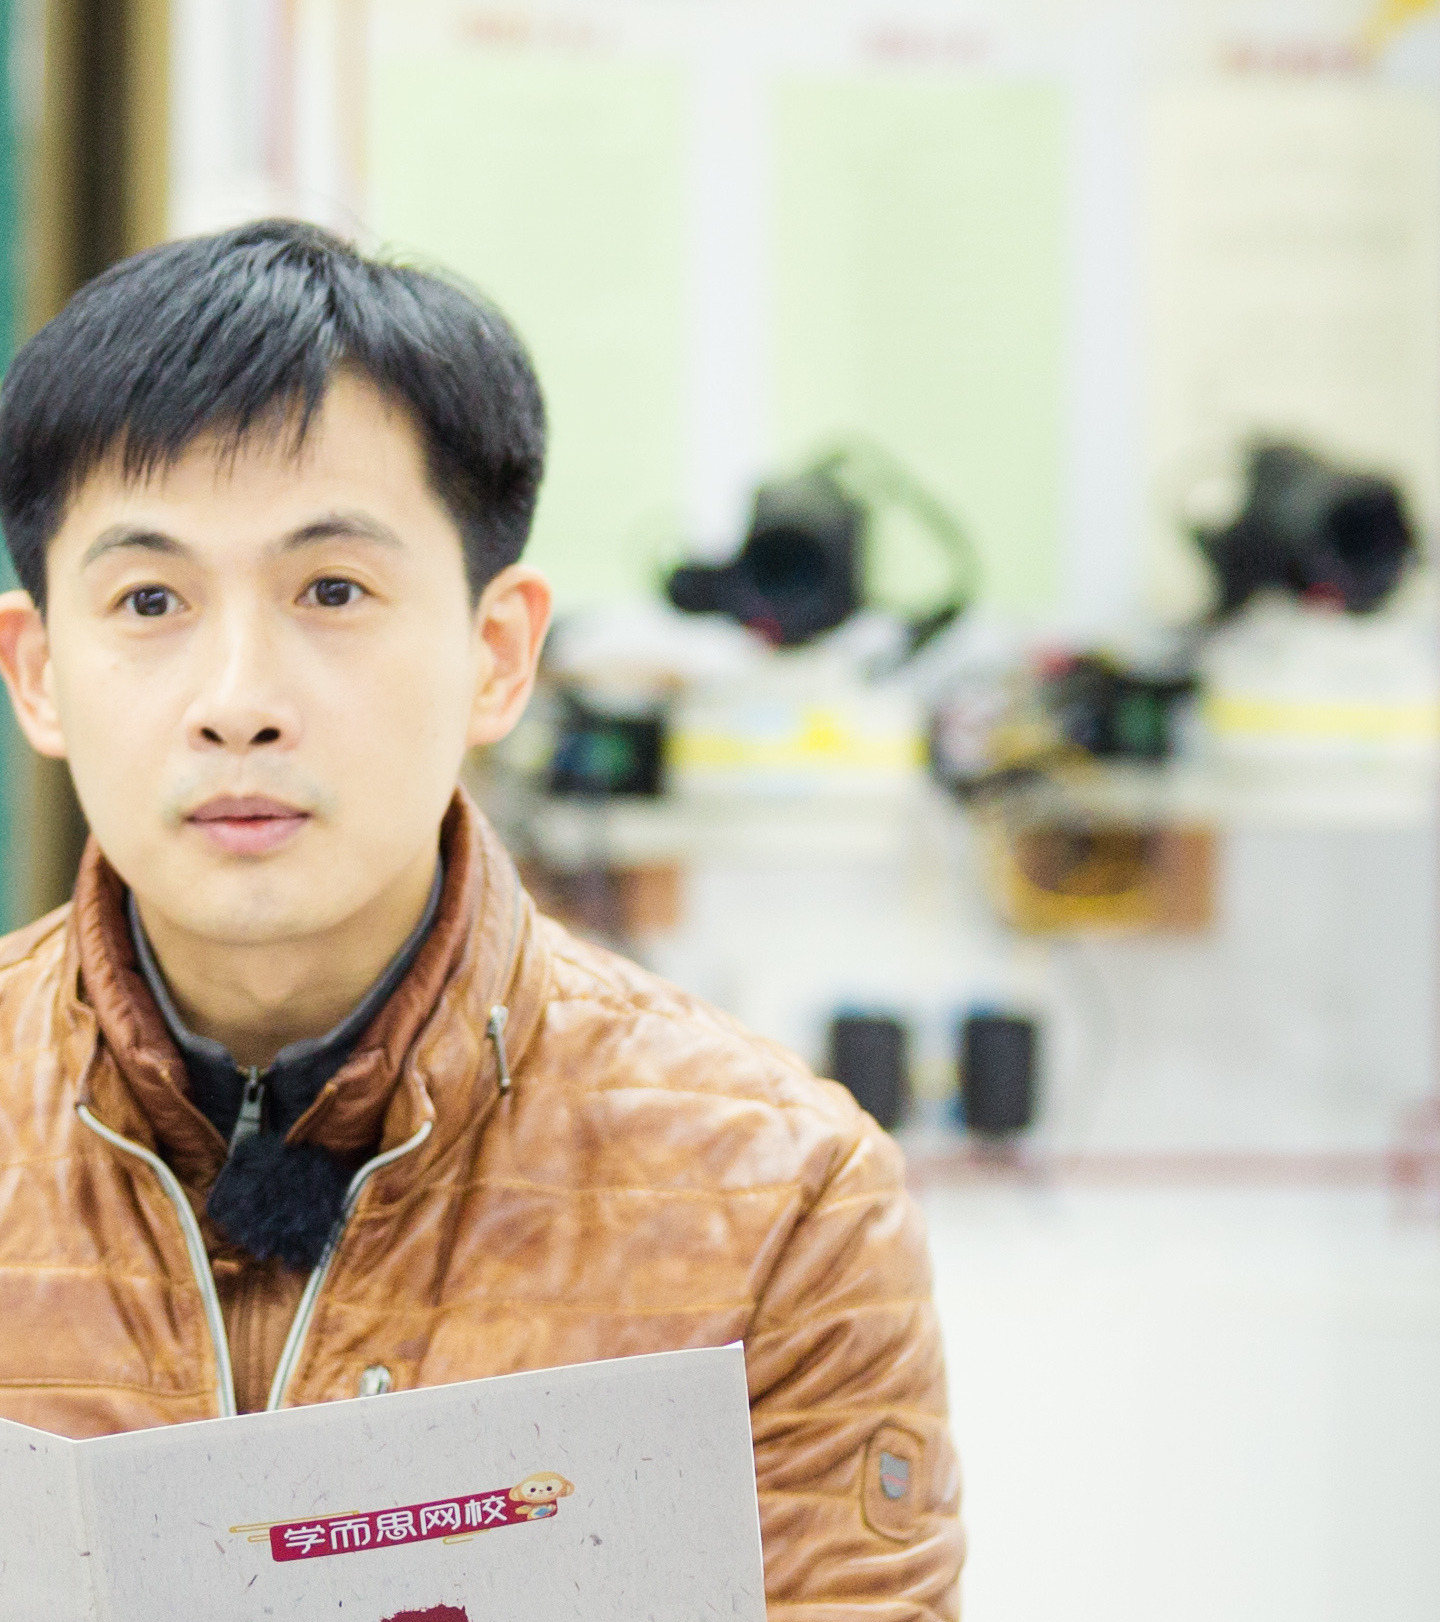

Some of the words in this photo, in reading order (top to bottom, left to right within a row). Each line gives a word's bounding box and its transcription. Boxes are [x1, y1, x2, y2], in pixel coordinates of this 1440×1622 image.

[284, 1495, 508, 1554] 学而思网校
